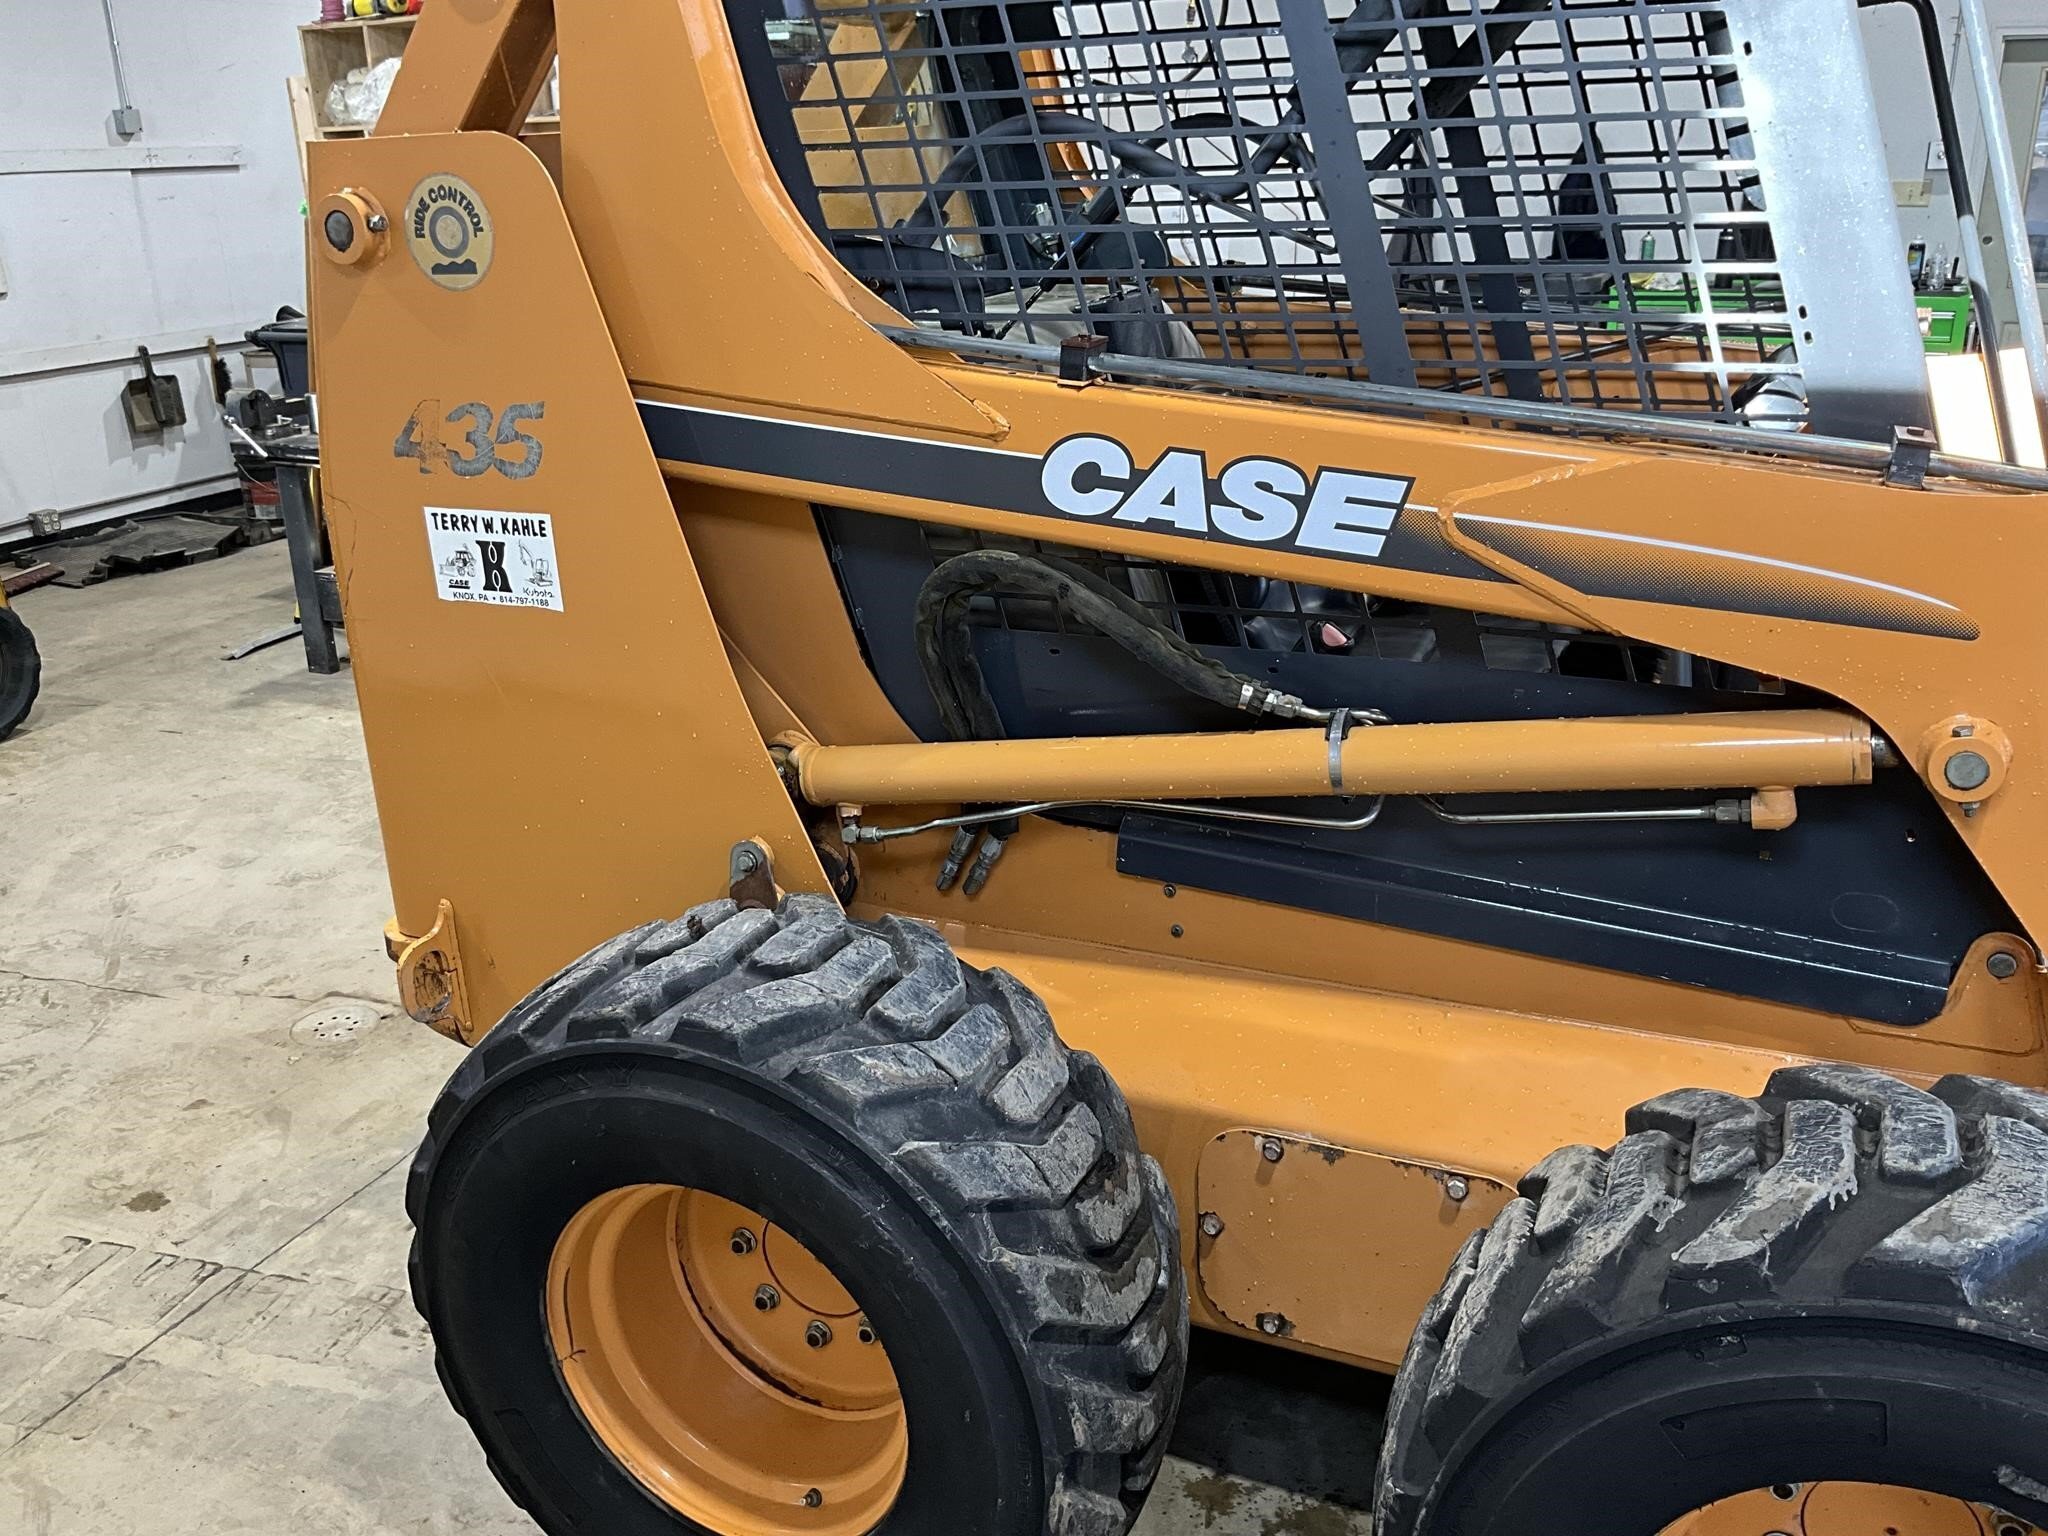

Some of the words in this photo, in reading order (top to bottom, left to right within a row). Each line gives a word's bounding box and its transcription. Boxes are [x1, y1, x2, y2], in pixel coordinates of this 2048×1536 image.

[414, 197, 430, 238] RIDE
[428, 184, 484, 238] CONTROL
[394, 399, 544, 480] 435
[430, 512, 478, 533] TERRY
[481, 516, 499, 534] W.
[500, 517, 548, 537] KAHLE
[1041, 437, 1408, 558] CASE
[478, 593, 490, 601] PA
[499, 595, 549, 607] 814-797-1188
